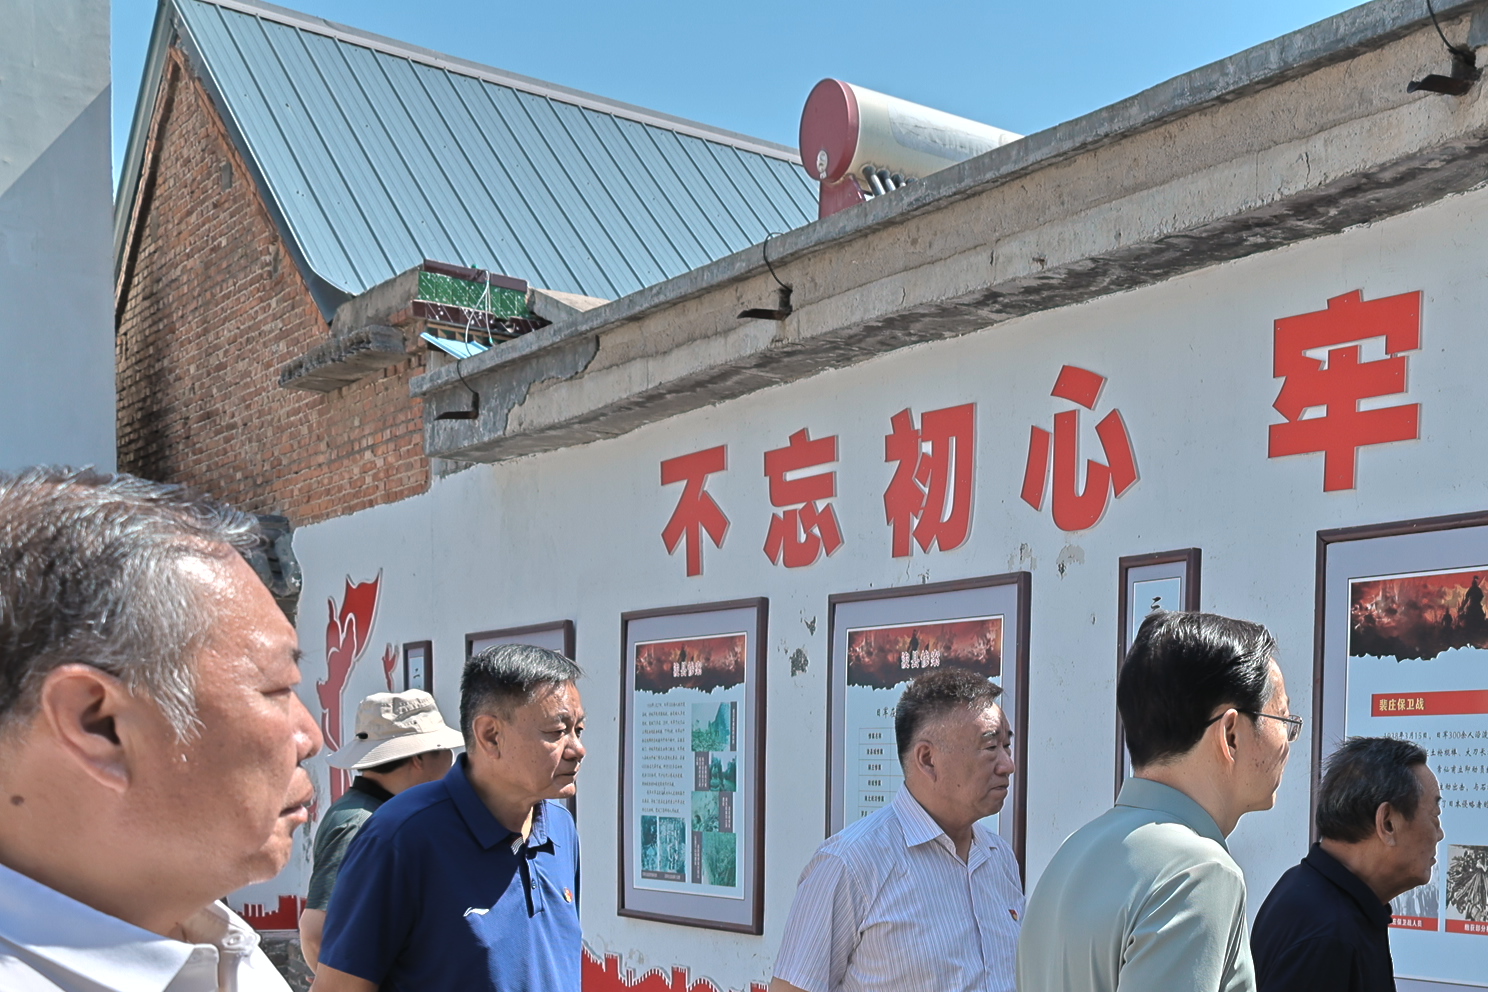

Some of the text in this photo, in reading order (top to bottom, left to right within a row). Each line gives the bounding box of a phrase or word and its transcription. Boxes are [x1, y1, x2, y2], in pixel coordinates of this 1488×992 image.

[660, 364, 1139, 577] 不忘初心
[1379, 697, 1425, 711] 裴庄保卫战
